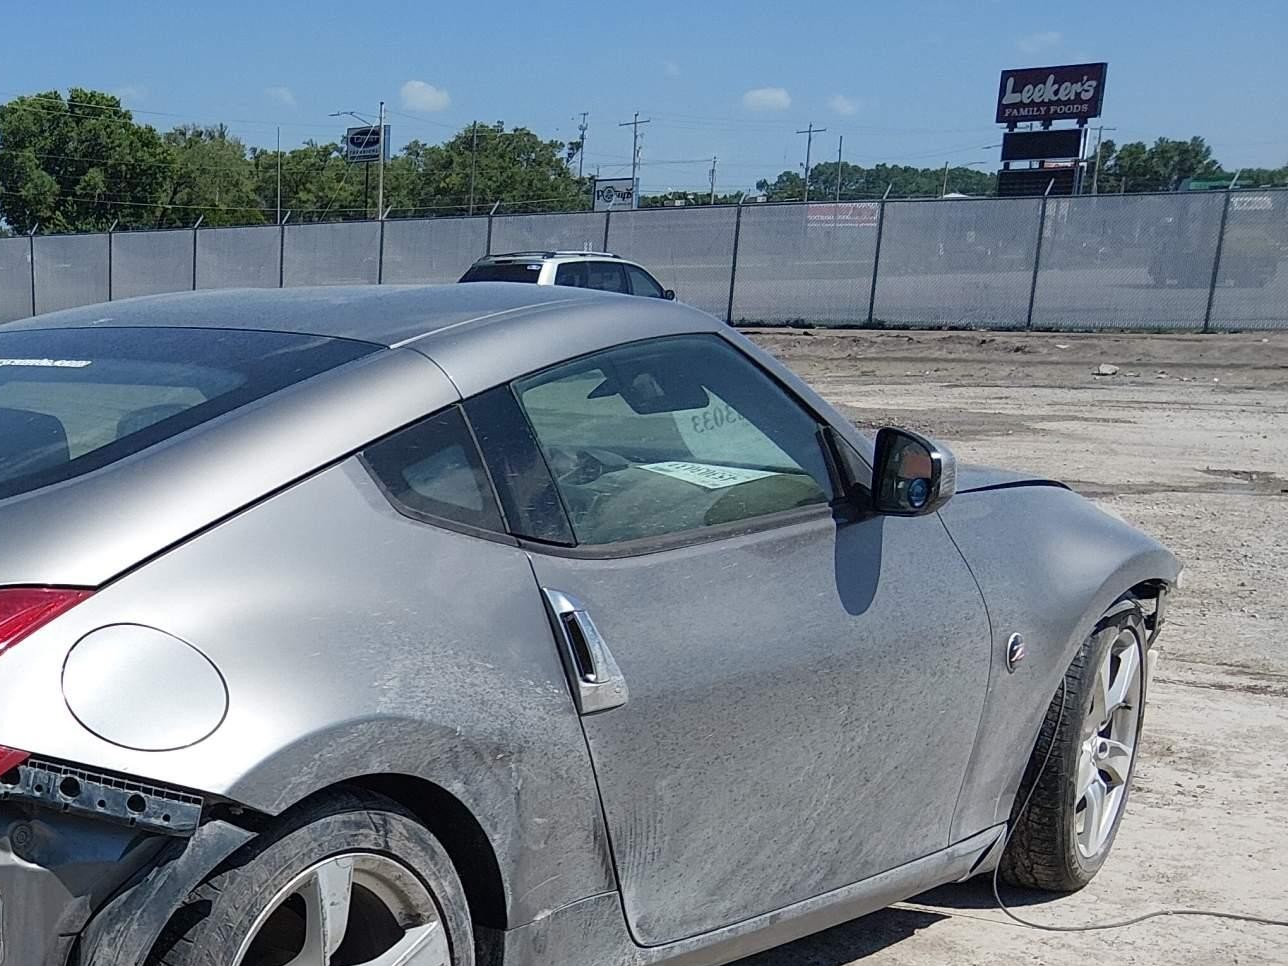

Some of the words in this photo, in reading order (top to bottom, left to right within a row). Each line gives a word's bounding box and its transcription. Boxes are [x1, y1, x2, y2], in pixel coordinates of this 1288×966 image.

[1002, 74, 1097, 104] Leeker's
[1004, 107, 1047, 117] FAMILY
[1049, 104, 1089, 114] FOODS
